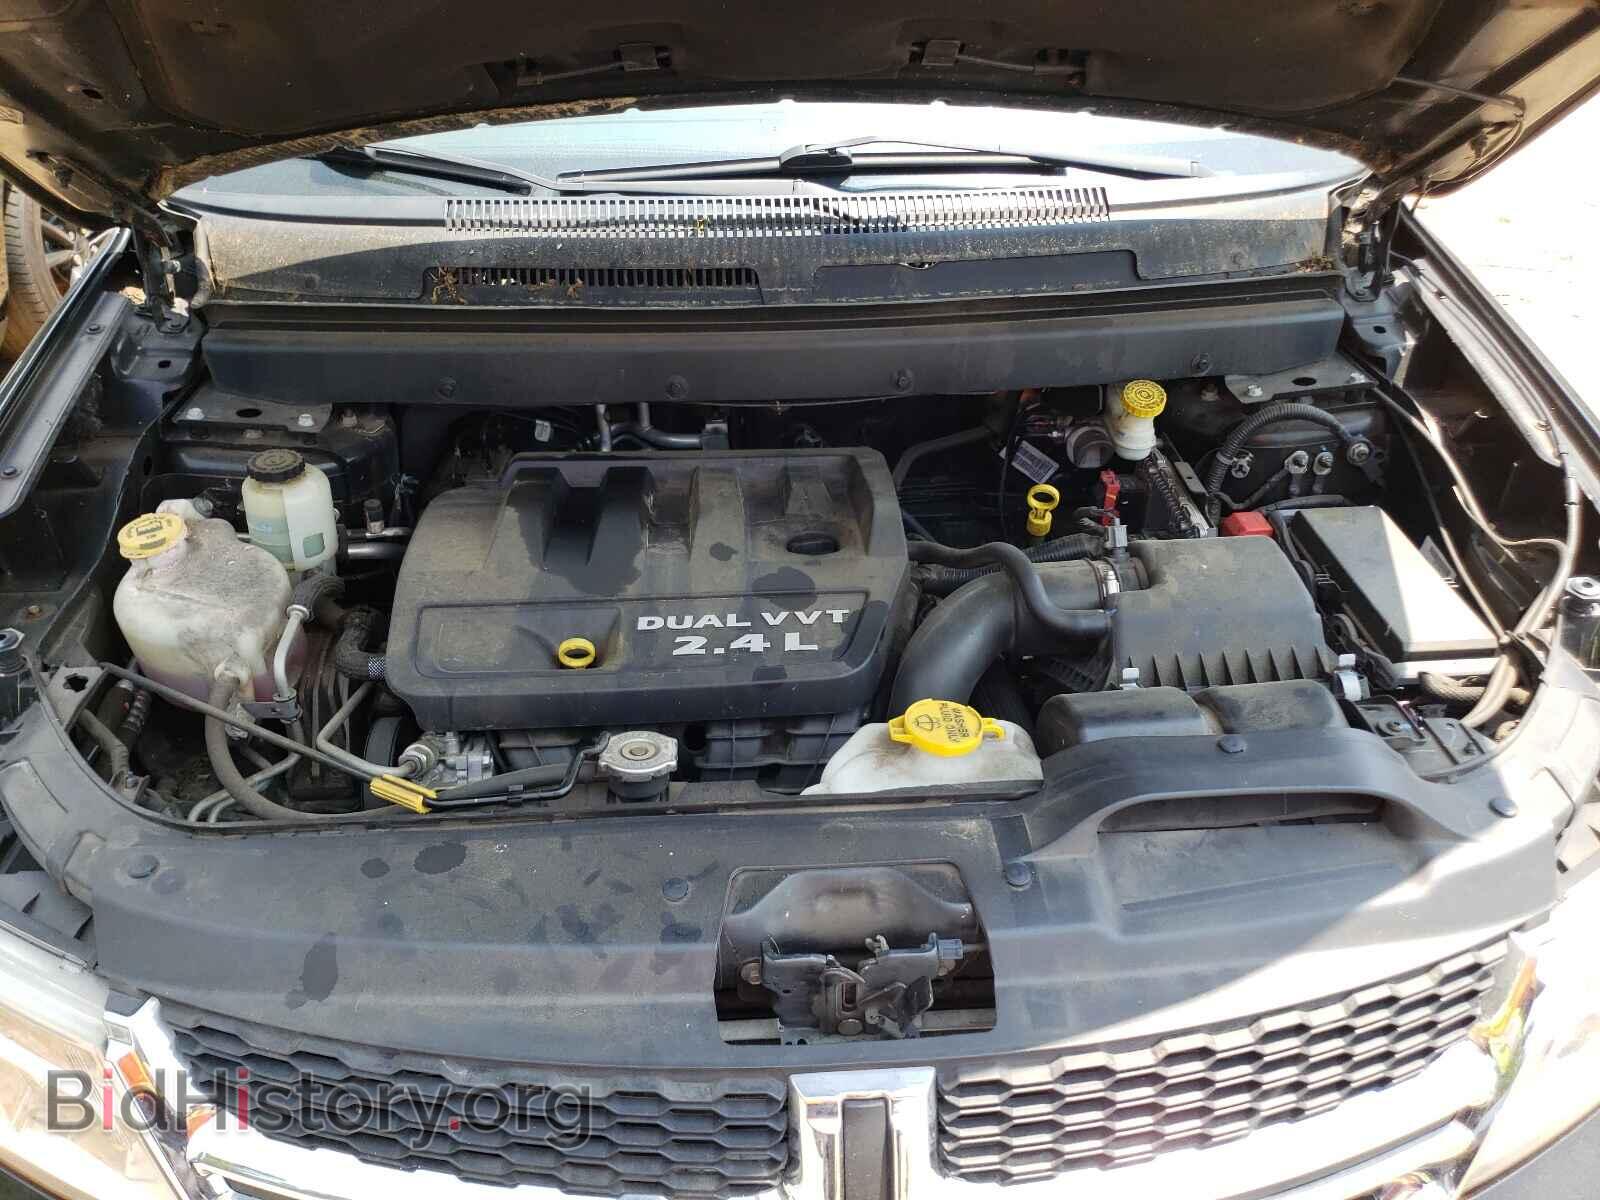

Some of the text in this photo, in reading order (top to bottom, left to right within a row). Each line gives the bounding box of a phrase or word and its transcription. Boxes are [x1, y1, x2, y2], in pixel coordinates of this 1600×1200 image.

[637, 609, 849, 631] DUAL VVT
[672, 632, 819, 656] 2.4 L
[952, 707, 970, 738] WASHER
